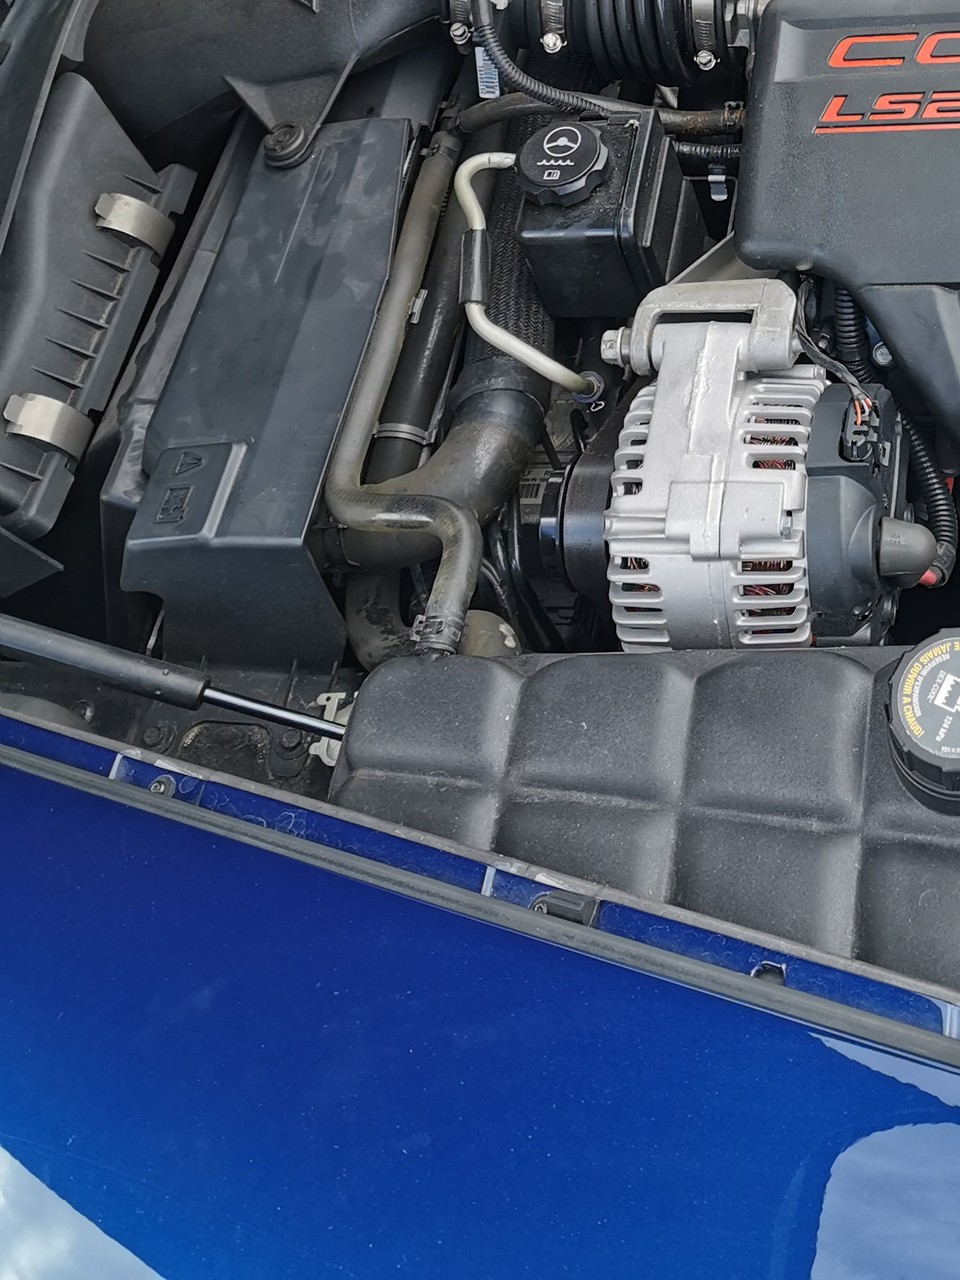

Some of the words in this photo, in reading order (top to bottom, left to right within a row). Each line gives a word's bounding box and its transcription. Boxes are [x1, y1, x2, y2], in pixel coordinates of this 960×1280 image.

[919, 642, 952, 665] JAMAIS
[903, 662, 923, 695] OUVRIR
[903, 705, 925, 738] CHAUD!
[942, 715, 953, 728] 124
[936, 727, 947, 742] kPa
